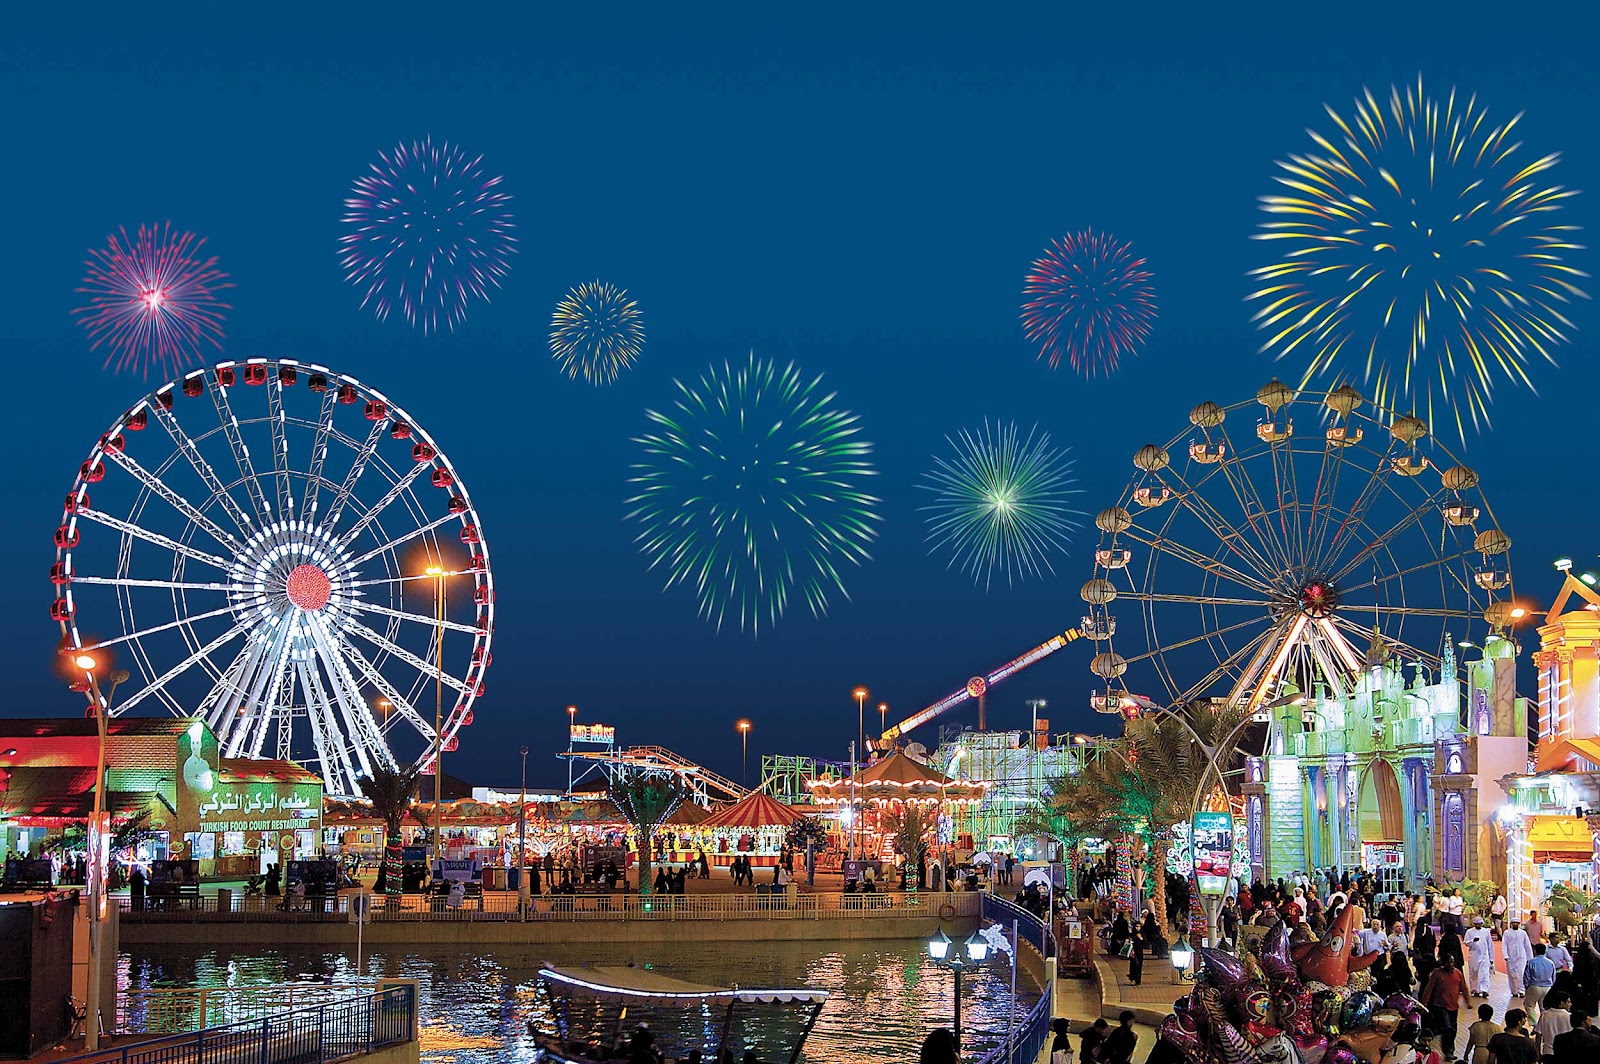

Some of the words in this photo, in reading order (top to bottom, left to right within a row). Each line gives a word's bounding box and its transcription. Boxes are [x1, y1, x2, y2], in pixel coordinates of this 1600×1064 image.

[199, 792, 242, 819] التركي
[244, 792, 278, 814] الركن
[279, 792, 309, 813] مطعم
[200, 821, 229, 832] TURKISH
[230, 821, 247, 831] FOOD
[249, 820, 271, 831] COURT
[271, 819, 310, 830] RESTAURANT
